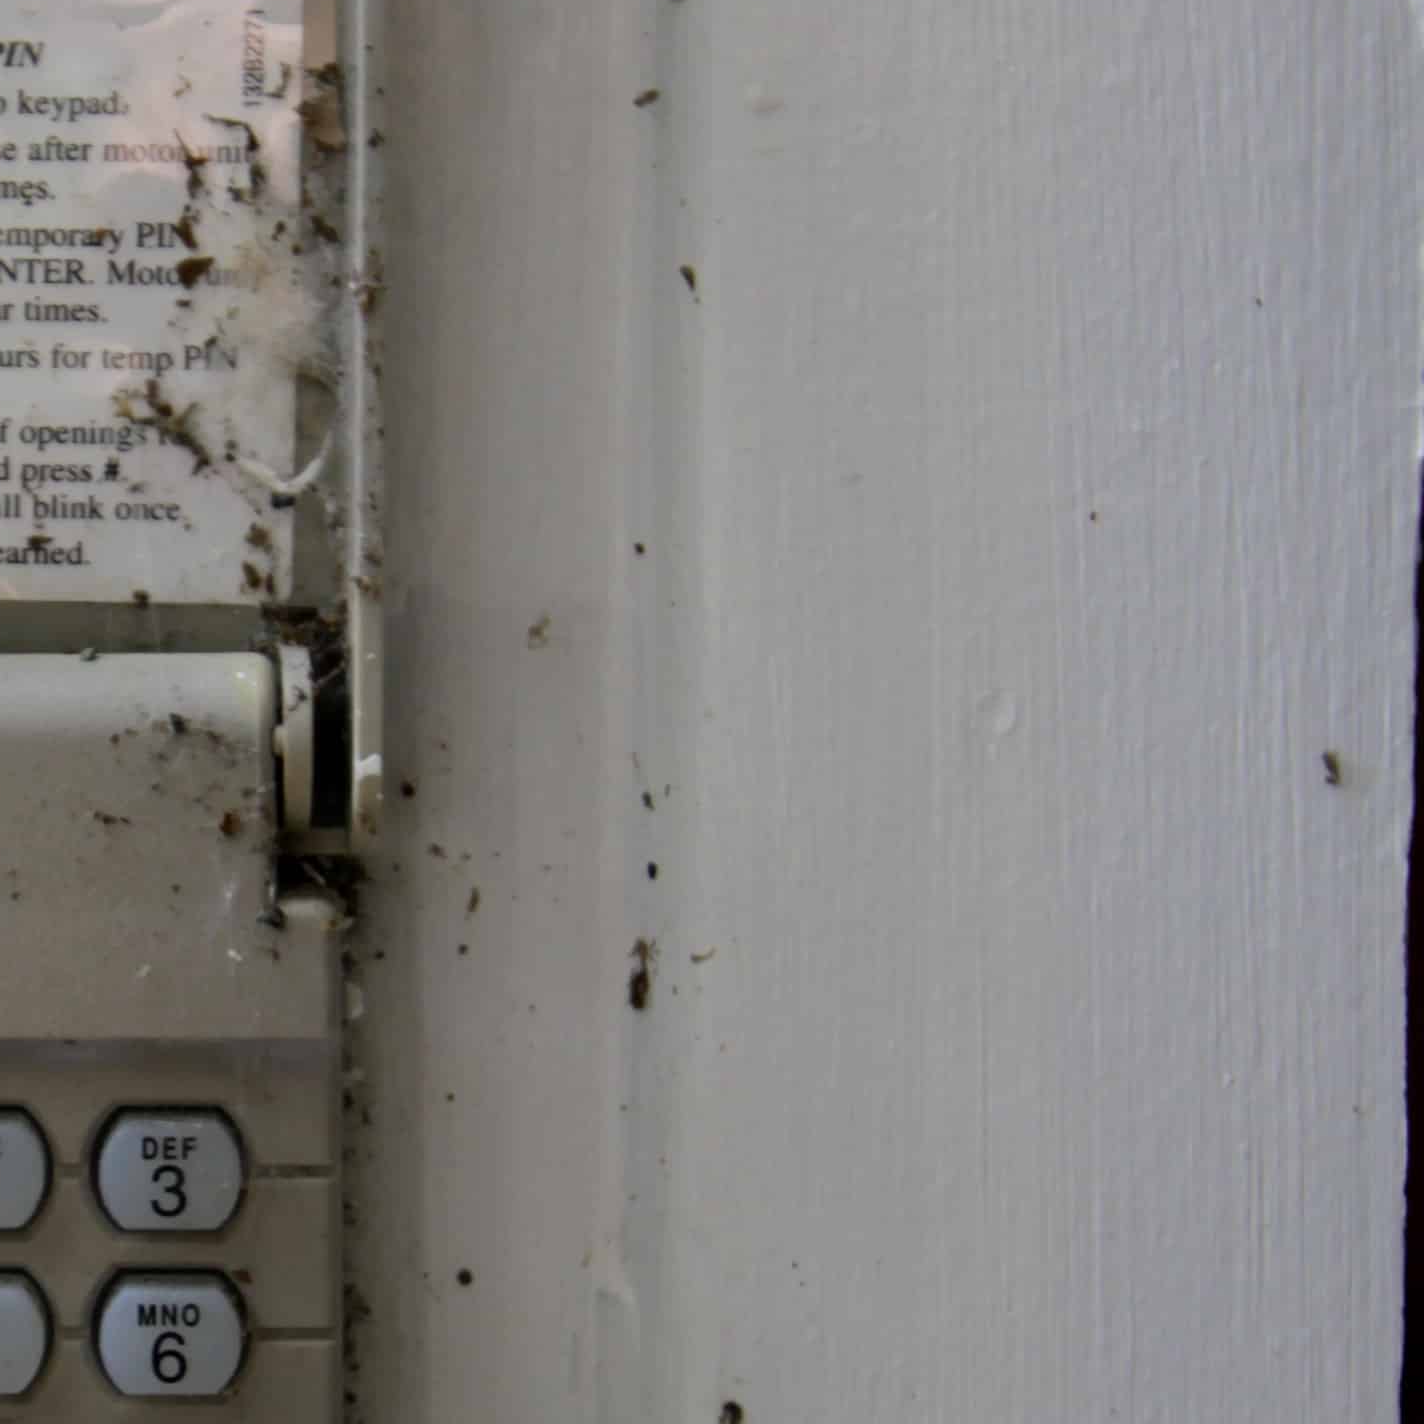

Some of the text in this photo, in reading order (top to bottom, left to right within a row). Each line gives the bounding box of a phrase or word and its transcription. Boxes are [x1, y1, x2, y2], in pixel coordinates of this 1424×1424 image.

[28, 135, 95, 163] after
[24, 296, 108, 324] times.
[51, 342, 91, 370] for
[101, 346, 174, 377] temp
[22, 463, 92, 490] press
[32, 493, 103, 521] blink
[141, 1136, 197, 1161] DEF
[151, 1164, 188, 1218] 3
[137, 1303, 201, 1328] MNO
[151, 1331, 188, 1384] 6
